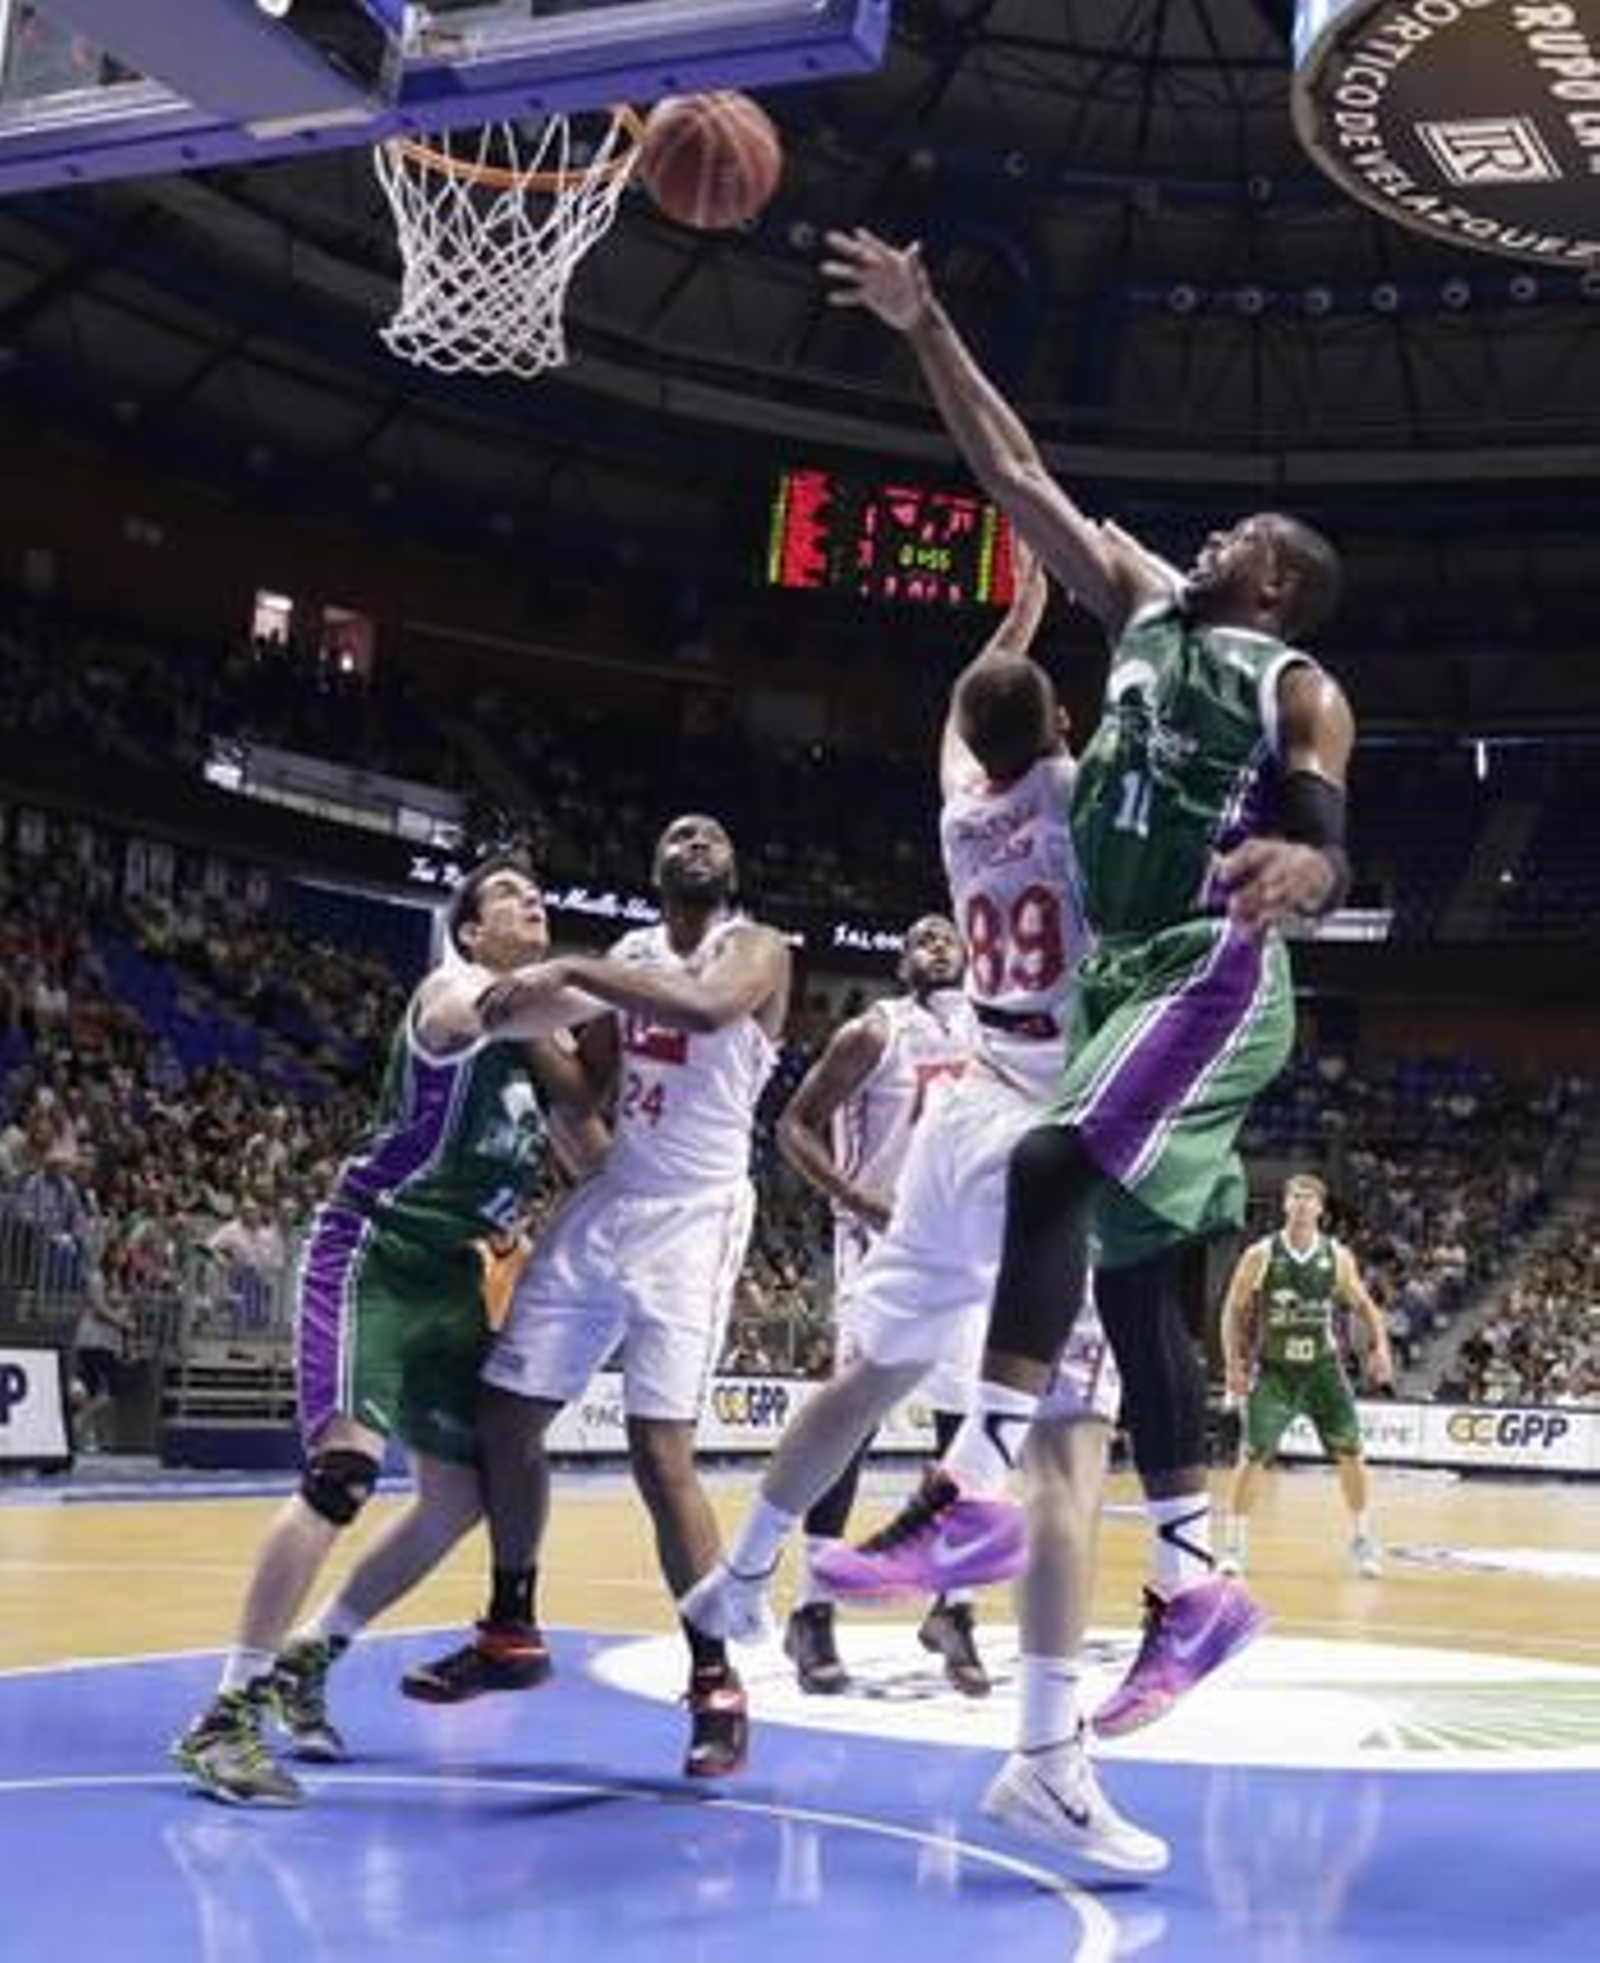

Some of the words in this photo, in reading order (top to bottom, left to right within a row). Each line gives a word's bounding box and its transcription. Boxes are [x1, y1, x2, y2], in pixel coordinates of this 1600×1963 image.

[1336, 0, 1495, 107] ORTICO
[1511, 0, 1600, 100] RUPO
[967, 883, 1064, 996] 89
[623, 1072, 665, 1129] 24
[1498, 1413, 1569, 1447] GPP
